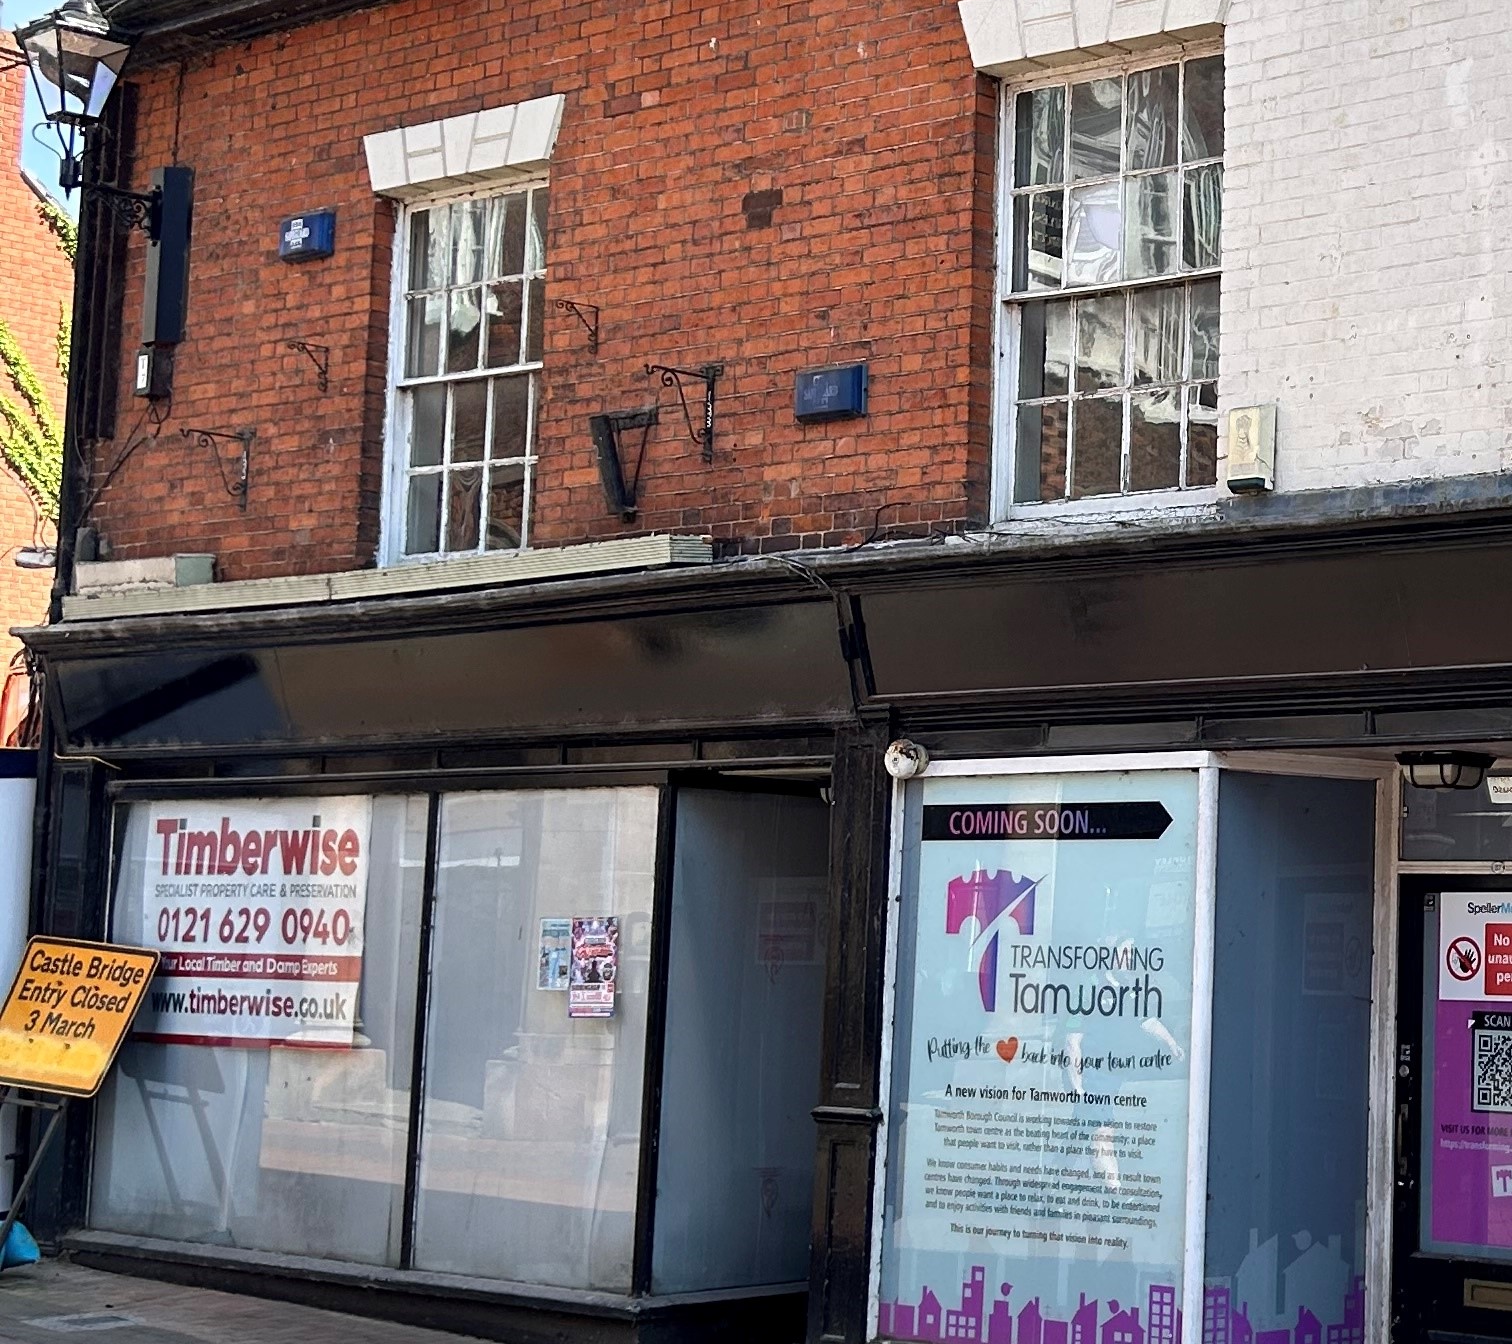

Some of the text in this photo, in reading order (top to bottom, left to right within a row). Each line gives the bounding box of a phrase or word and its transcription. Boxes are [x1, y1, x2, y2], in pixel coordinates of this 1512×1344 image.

[950, 810, 1106, 835] COMING SOON...
[157, 815, 360, 876] Timberwise
[155, 884, 356, 898] SPECIALIST PROPERTY CARE & PRESERVATION
[158, 907, 350, 945] 0121 629 0940
[1494, 934, 1510, 946] No
[30, 949, 144, 987] Castle Bridge
[179, 957, 204, 971] Local
[207, 956, 240, 972] Timber
[243, 958, 263, 972] and
[267, 959, 299, 976] Damp
[302, 960, 337, 977] Experts
[1011, 944, 1164, 971] TRANSFORMING
[19, 979, 132, 1013] Entry Closed
[152, 987, 347, 1020] www.timberwise.co.uk
[1009, 973, 1162, 1018] Tamworth
[24, 1010, 96, 1039] 3 March
[1484, 1015, 1511, 1026] SCAN
[927, 1036, 1172, 1074] Putting the back into your town centre
[945, 1084, 1147, 1107] A new vision for Tamworth town centre
[950, 1223, 963, 1233] This
[965, 1223, 971, 1233] is
[973, 1226, 984, 1235] our
[984, 1226, 1011, 1240] journey
[1013, 1229, 1020, 1238] to
[1049, 1231, 1063, 1241] that
[1066, 1233, 1086, 1243] vision
[1088, 1234, 1103, 1244] into
